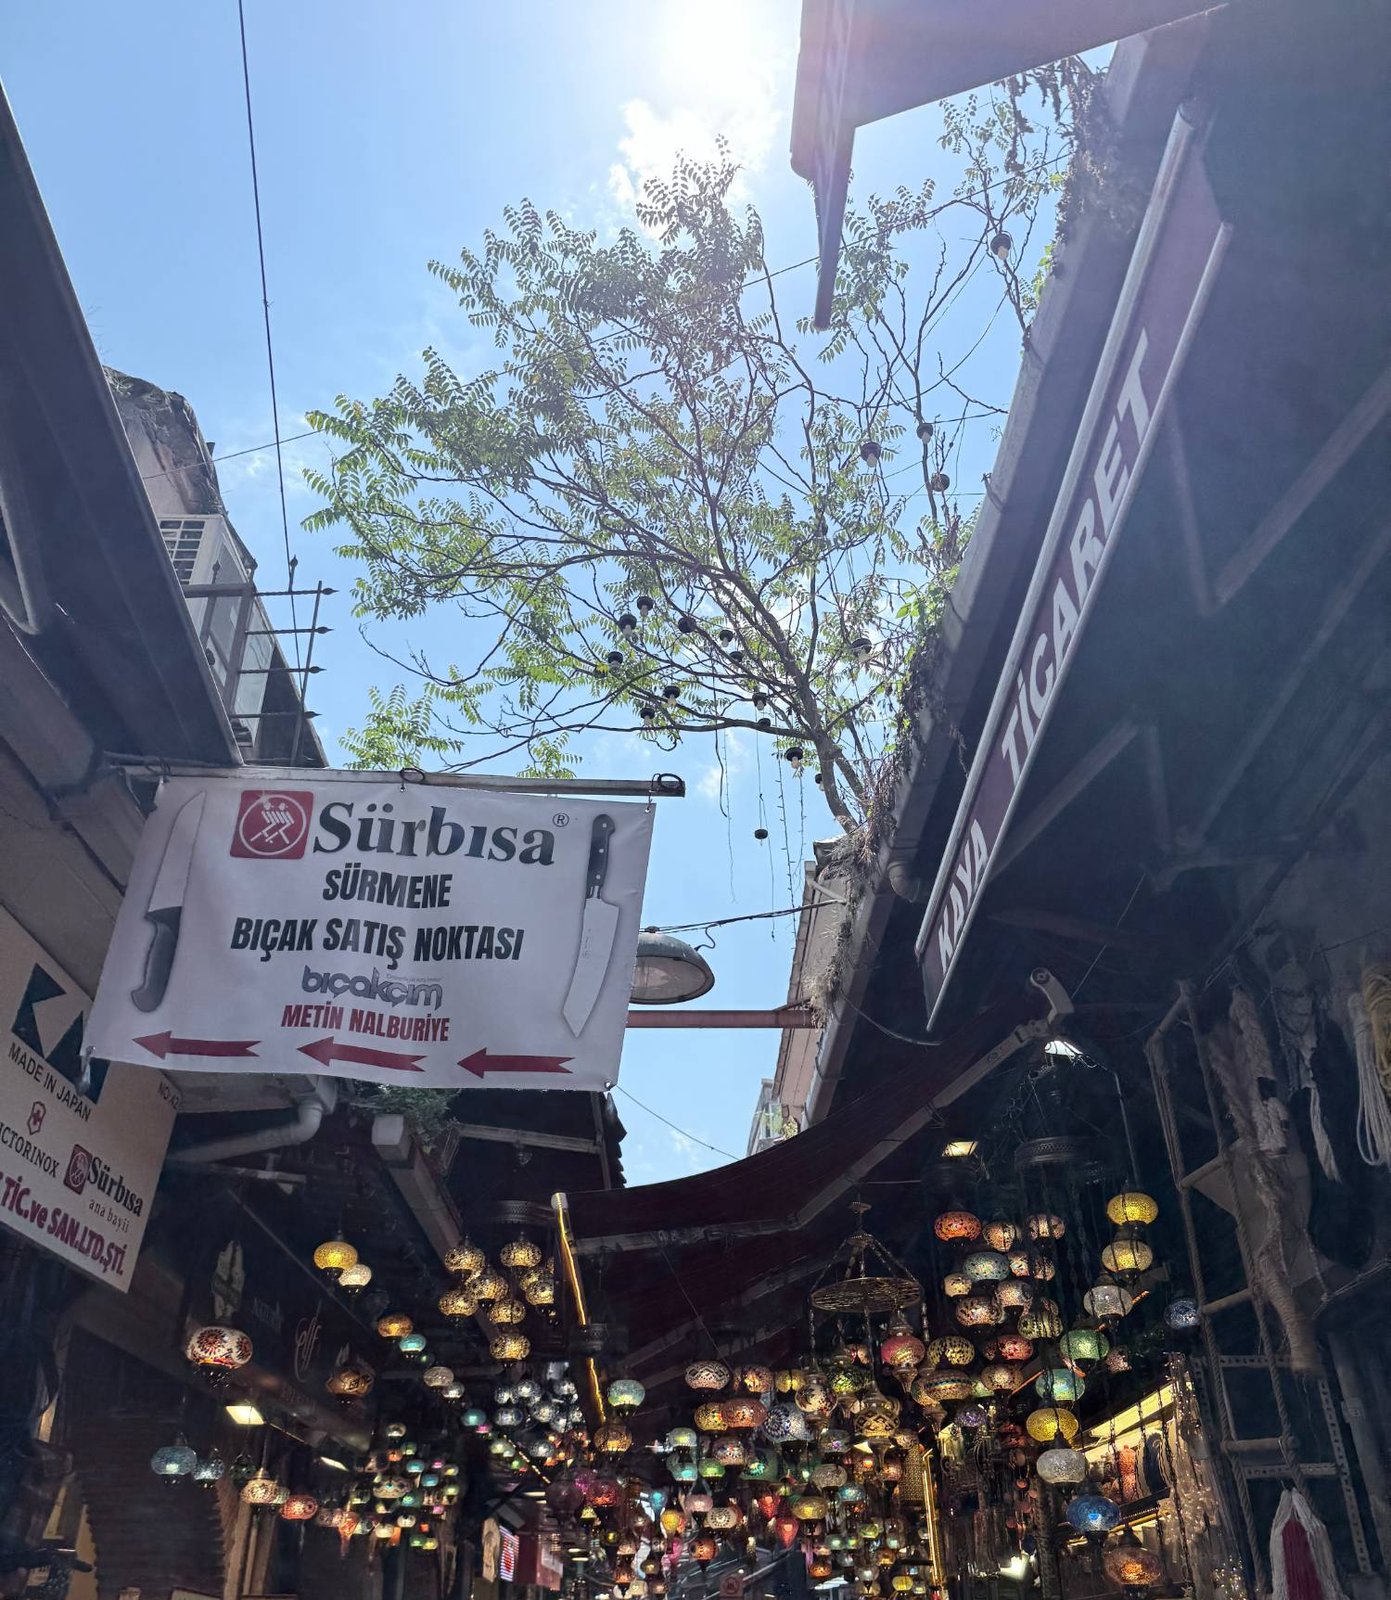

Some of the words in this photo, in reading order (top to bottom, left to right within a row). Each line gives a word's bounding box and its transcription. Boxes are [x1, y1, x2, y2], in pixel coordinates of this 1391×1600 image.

[937, 817, 990, 975] KAYA
[999, 327, 1152, 779] TİCARET
[311, 801, 556, 867] Sürbısa
[322, 862, 453, 909] SÜRMENE
[230, 916, 316, 962] BIÇAK
[322, 918, 406, 970] SATIŞ
[413, 926, 525, 962] NOKTASI
[281, 1002, 344, 1031] METİN
[348, 1009, 450, 1042] NALBURİYE
[8, 1042, 44, 1084] MADE
[43, 1071, 57, 1094] IN
[56, 1086, 91, 1122] JAPAN
[0, 1122, 60, 1178] ICTORINOX
